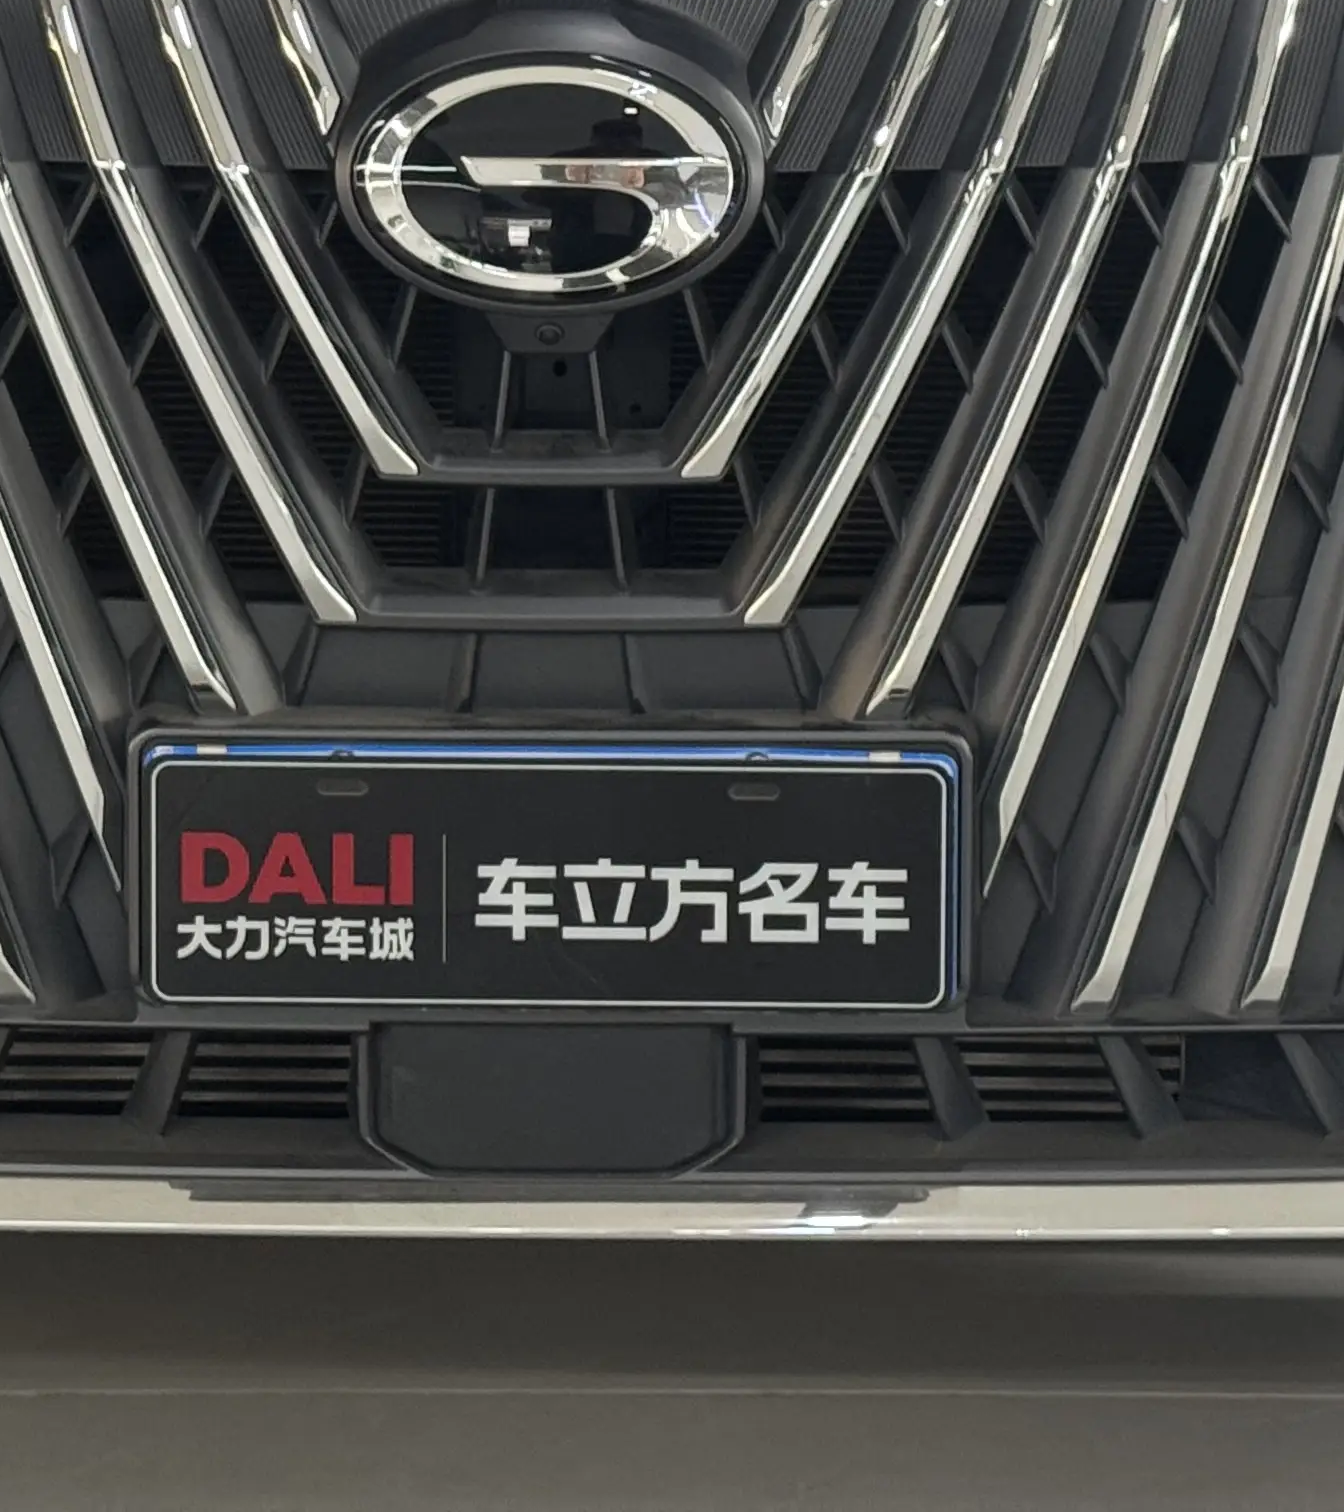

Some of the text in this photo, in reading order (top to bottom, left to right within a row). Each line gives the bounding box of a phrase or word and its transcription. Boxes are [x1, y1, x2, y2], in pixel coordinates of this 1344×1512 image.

[180, 832, 414, 905] DALI
[474, 858, 911, 944] 车立方名车
[176, 916, 415, 962] 大力汽车城
